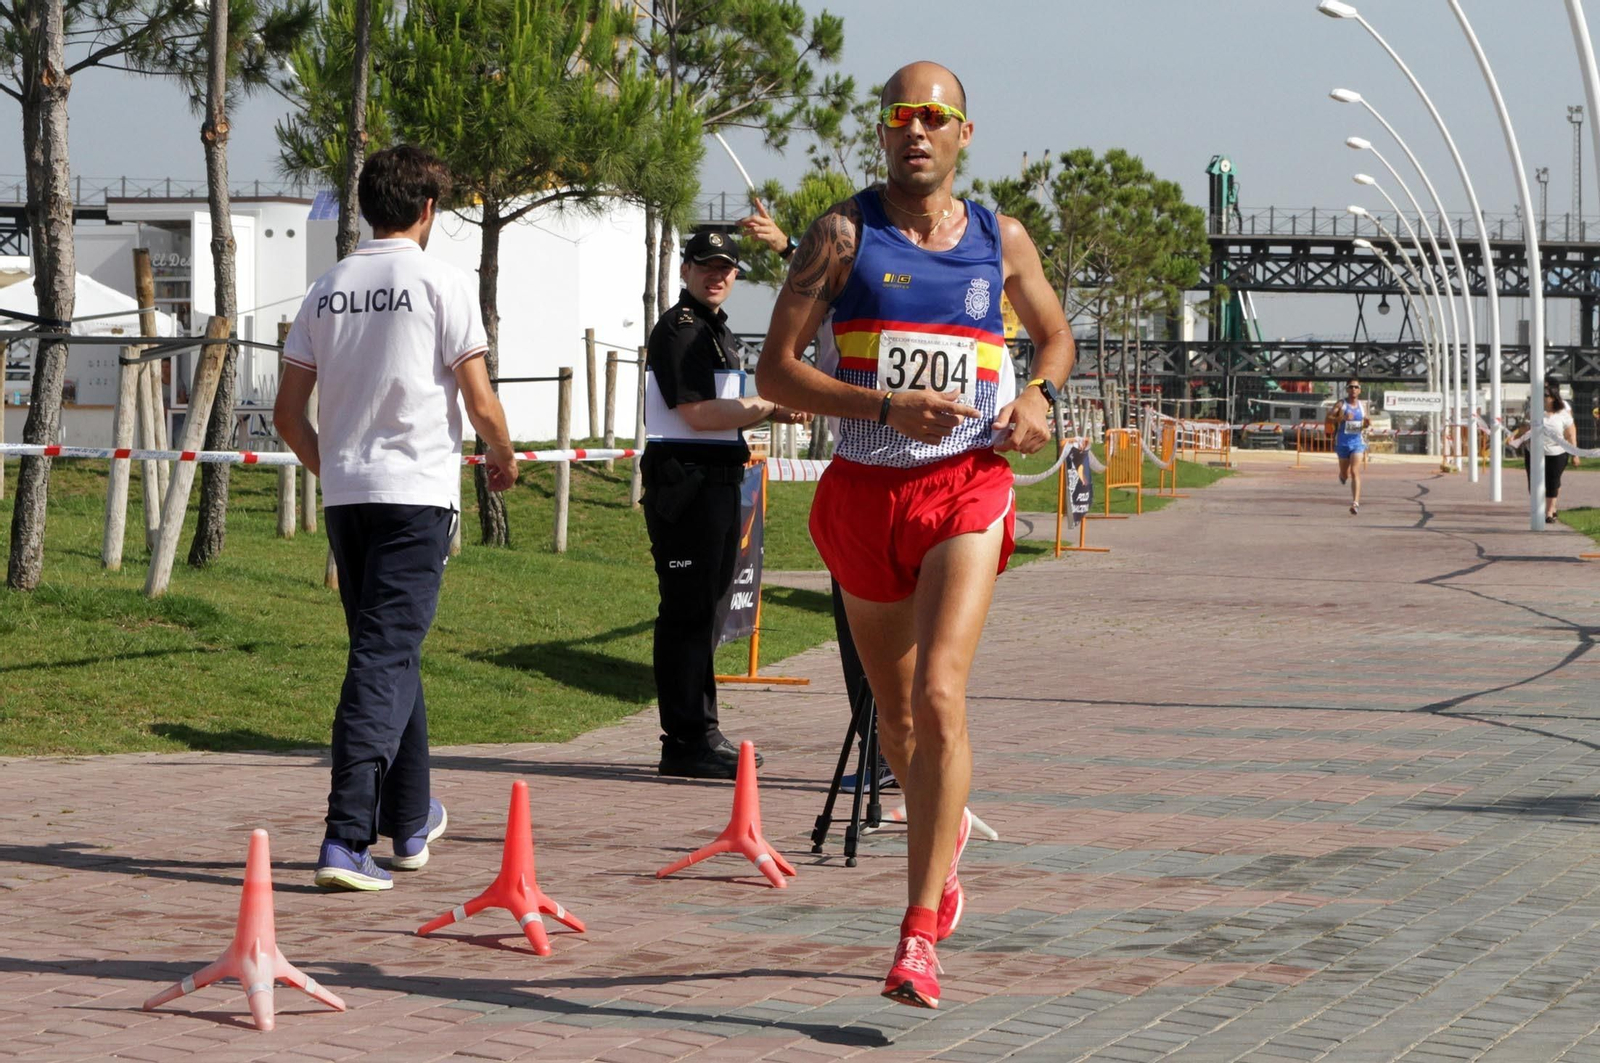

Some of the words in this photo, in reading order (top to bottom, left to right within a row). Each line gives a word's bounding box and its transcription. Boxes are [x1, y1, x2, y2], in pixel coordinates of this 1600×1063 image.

[316, 288, 413, 318] POLICIA
[886, 347, 968, 394] 3204
[669, 560, 692, 569] CNP
